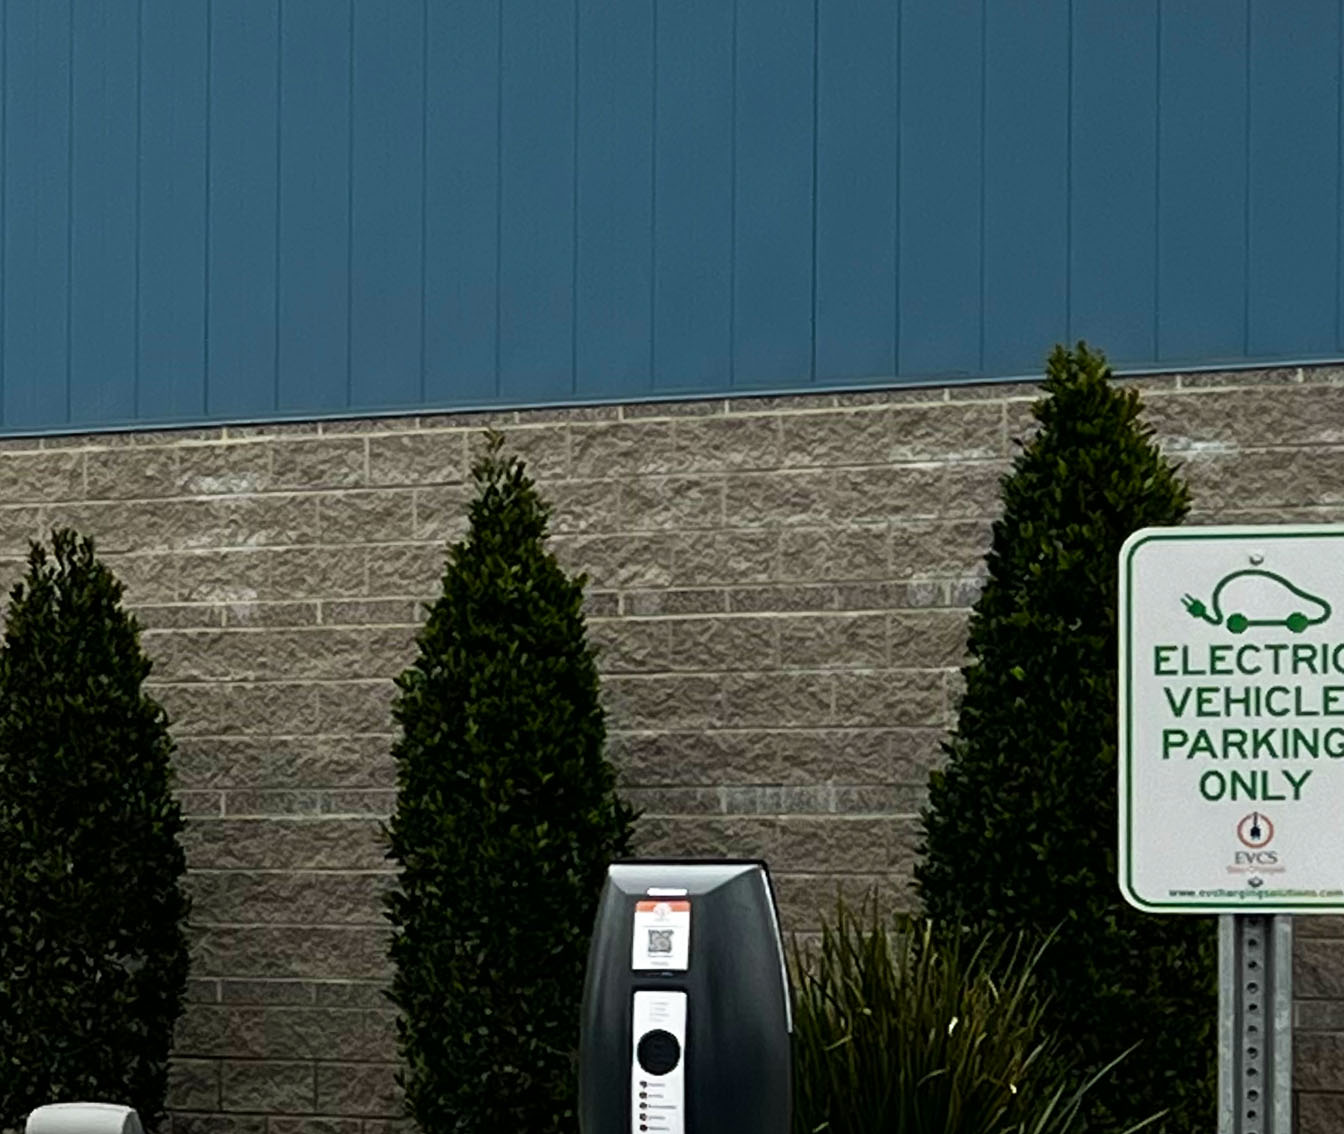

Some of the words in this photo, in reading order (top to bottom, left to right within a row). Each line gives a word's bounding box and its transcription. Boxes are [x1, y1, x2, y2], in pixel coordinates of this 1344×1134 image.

[1163, 685, 1344, 717] VEHICLE
[1162, 727, 1344, 760] PARKING
[1199, 770, 1313, 801] ONLY
[1235, 851, 1278, 865] EVCS
